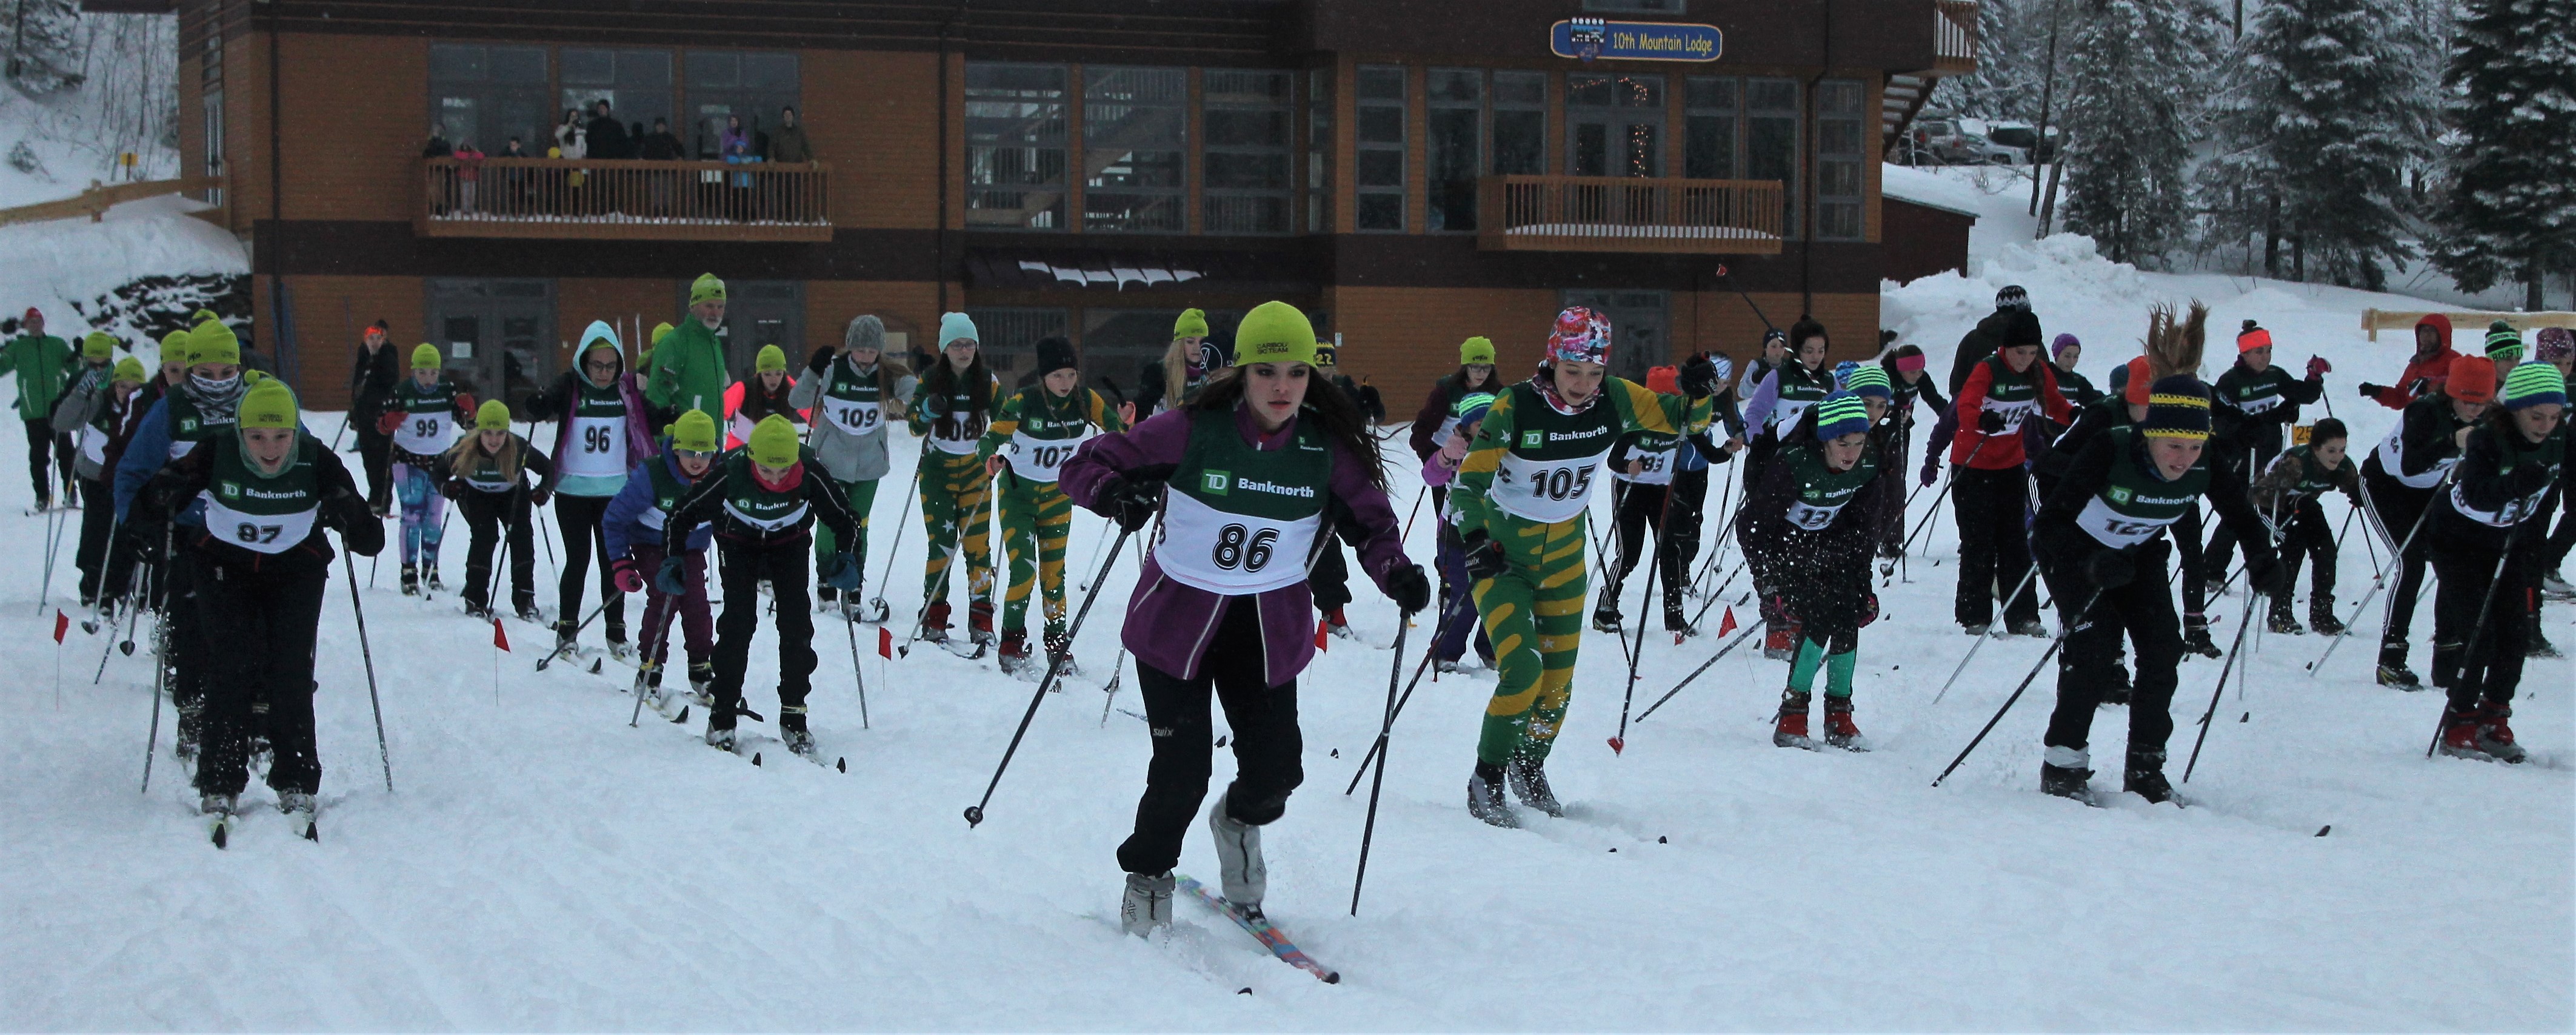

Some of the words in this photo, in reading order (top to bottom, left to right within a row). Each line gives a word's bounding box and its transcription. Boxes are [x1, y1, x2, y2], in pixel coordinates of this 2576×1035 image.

[1613, 32, 1635, 50] 10th
[1639, 33, 1682, 51] Mountain
[1686, 35, 1713, 56] Lodge
[416, 418, 438, 438] 99
[838, 407, 879, 428] 109
[584, 424, 611, 454] 96
[1526, 433, 1541, 445] TD
[1549, 424, 1608, 441] Banknorth
[1032, 444, 1075, 469] 107
[245, 487, 307, 500] Banknorth
[1205, 473, 1227, 491] TD
[1238, 477, 1315, 498] Banknorth
[1530, 463, 1597, 501] 105
[2135, 494, 2196, 505] Banknorth
[236, 521, 284, 544] 87
[1212, 522, 1281, 573] 86
